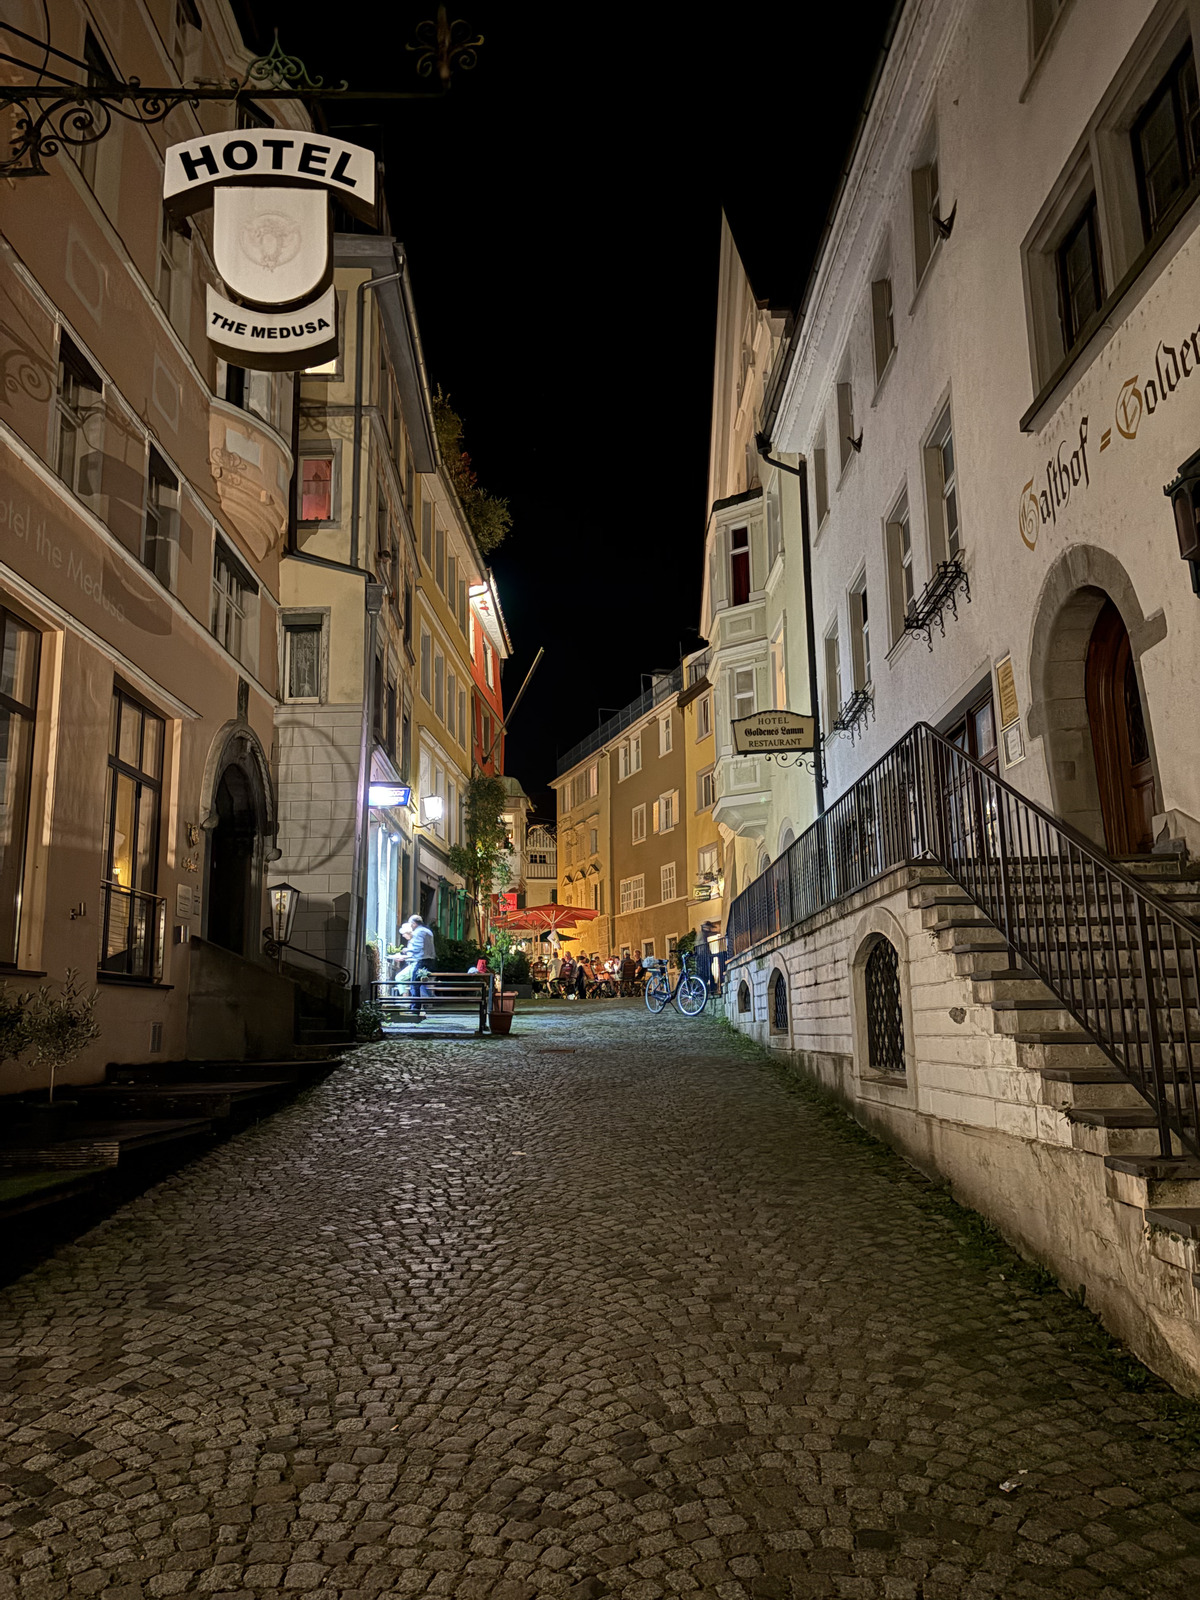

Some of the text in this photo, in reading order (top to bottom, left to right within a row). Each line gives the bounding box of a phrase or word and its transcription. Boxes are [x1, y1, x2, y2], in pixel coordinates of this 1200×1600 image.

[179, 139, 357, 188] HOTEL
[211, 312, 330, 339] THE MEDUSA
[36, 519, 62, 569] the
[758, 717, 789, 725] HOTEL
[744, 726, 804, 737] Goldenes Lamm
[748, 738, 802, 748] RESTAURANT
